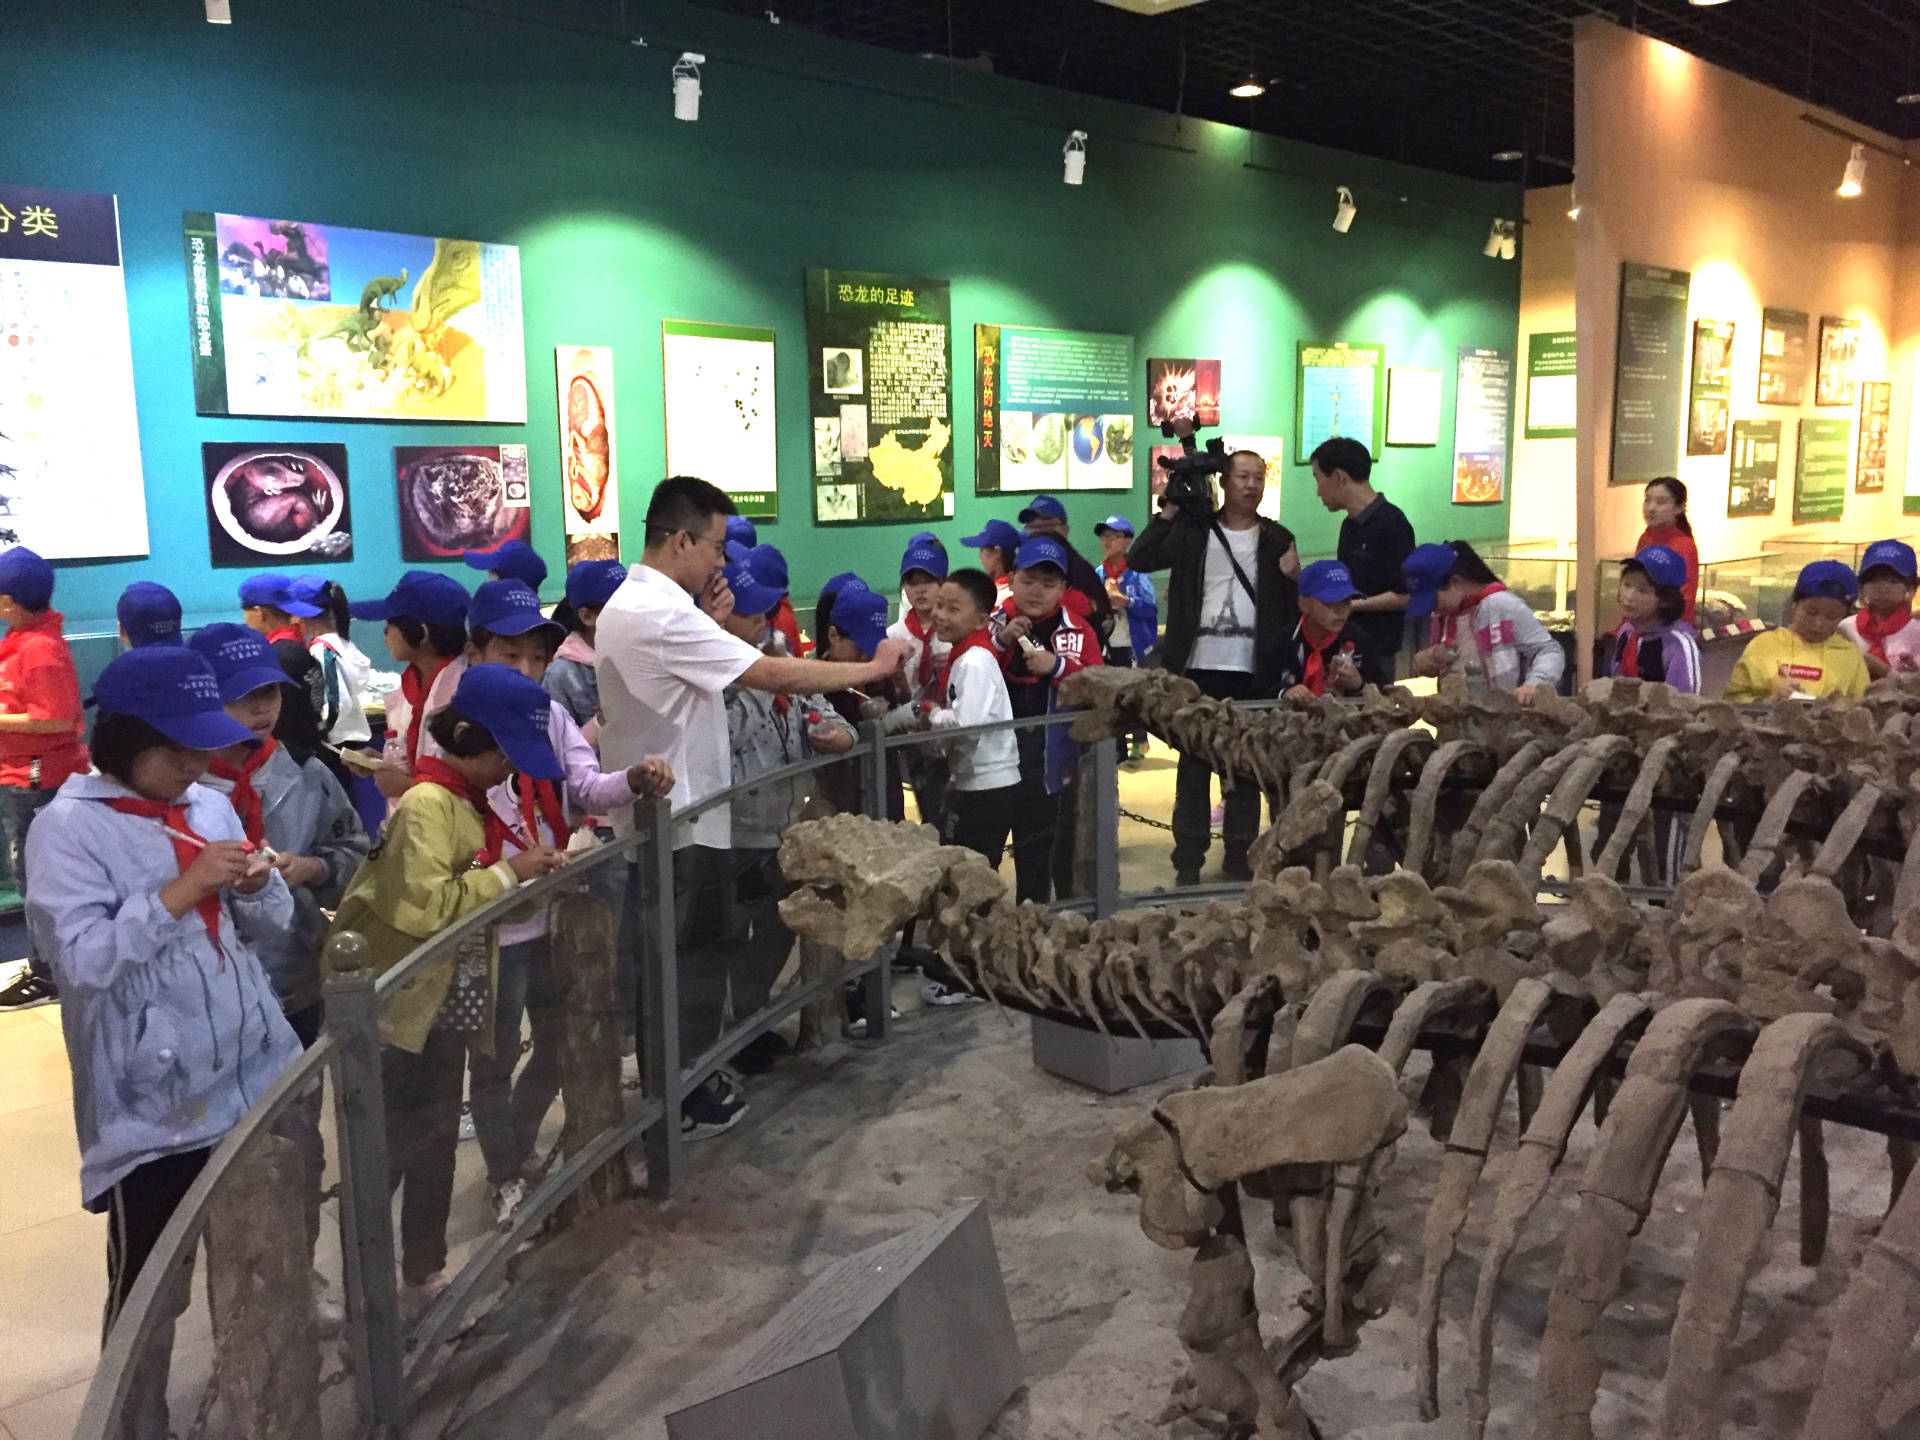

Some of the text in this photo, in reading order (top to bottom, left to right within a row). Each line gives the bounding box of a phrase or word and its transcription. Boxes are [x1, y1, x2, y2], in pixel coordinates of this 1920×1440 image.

[838, 284, 915, 307] 恐龙的足迹
[983, 345, 997, 448] 恐龙的绝灭
[1489, 623, 1503, 645] 5
